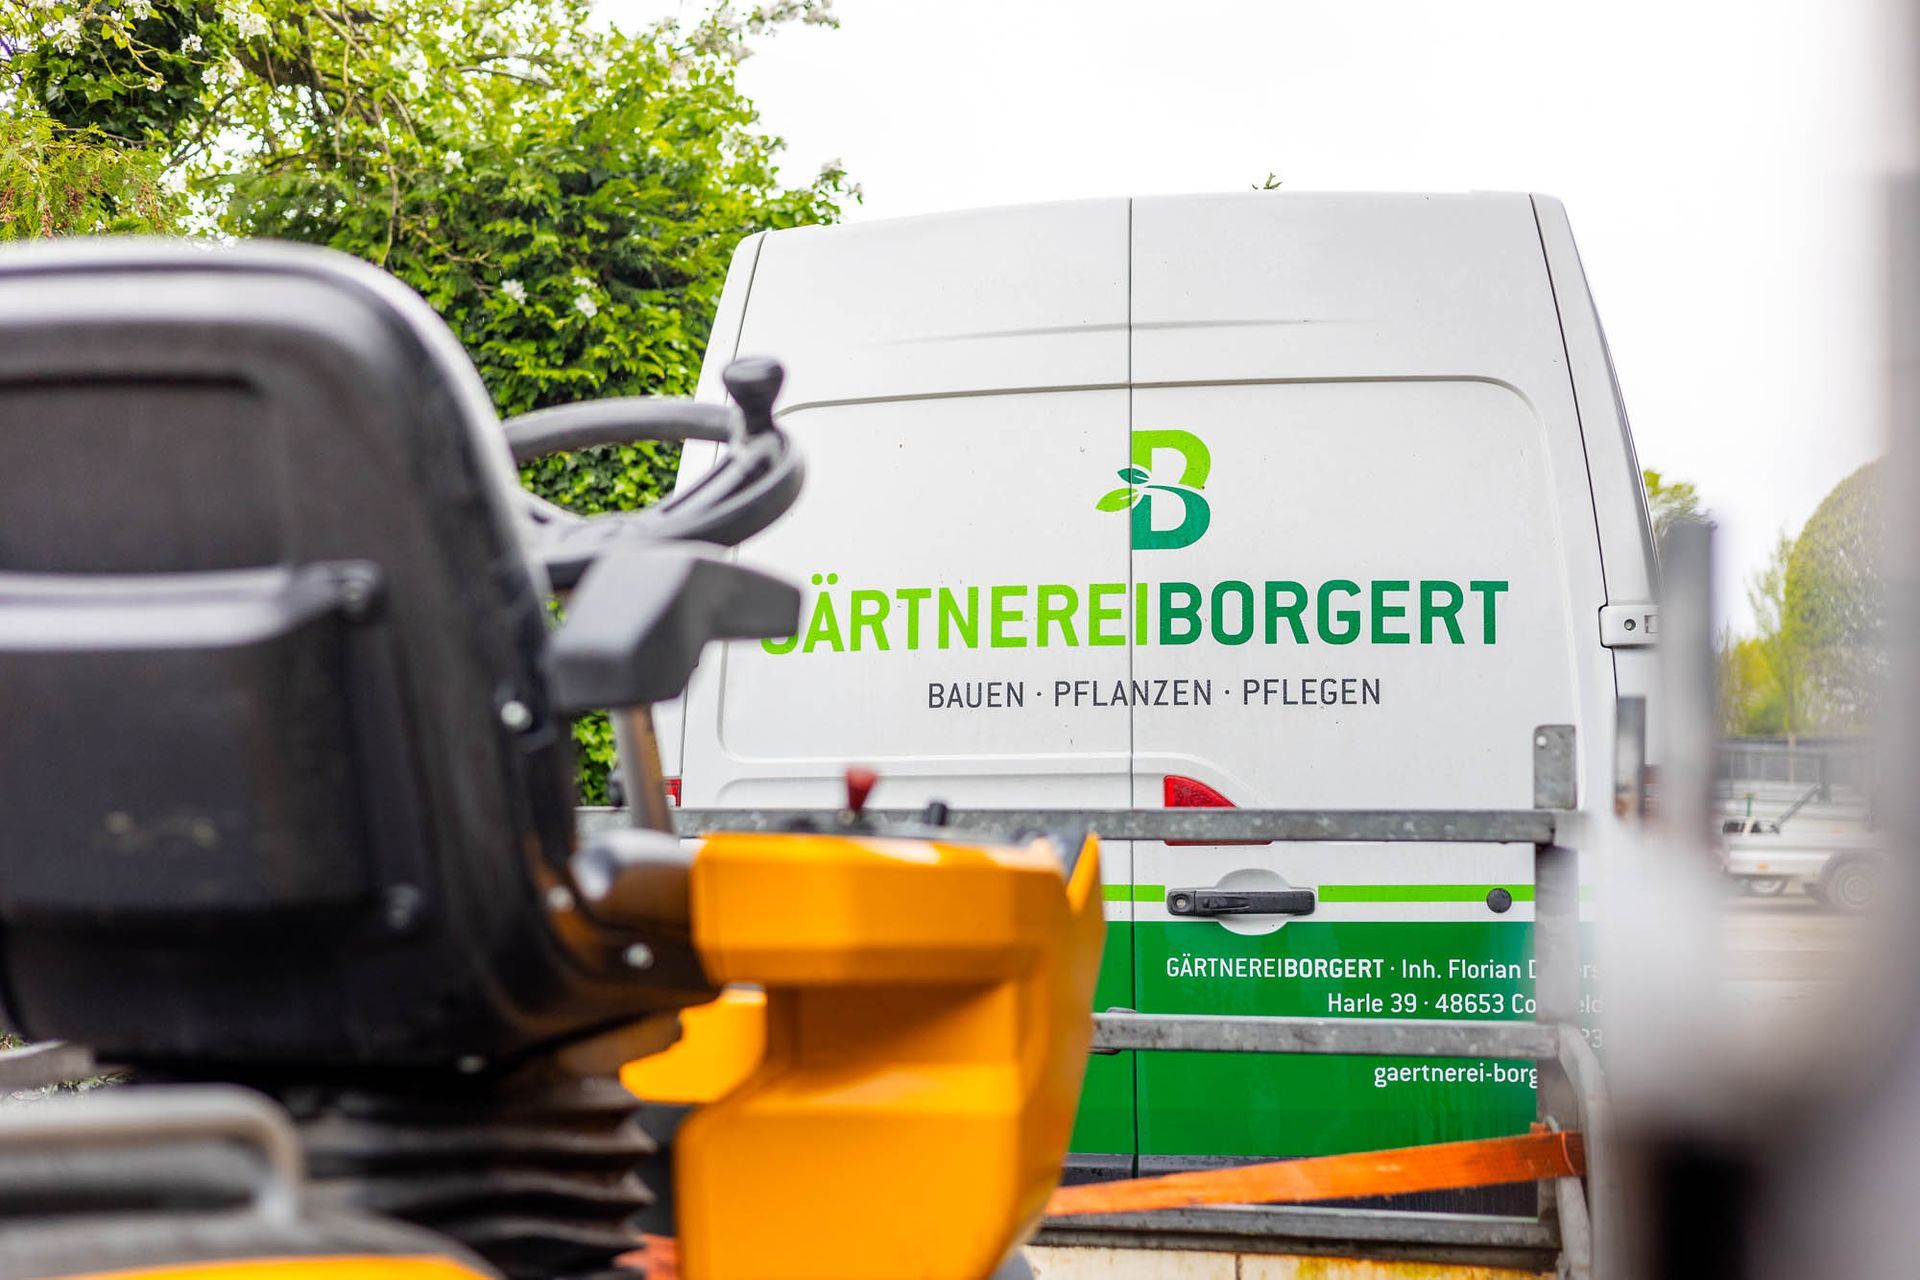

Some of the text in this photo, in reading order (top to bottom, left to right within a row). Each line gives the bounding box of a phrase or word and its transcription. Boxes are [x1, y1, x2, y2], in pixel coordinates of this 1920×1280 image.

[1131, 430, 1211, 550] B
[761, 572, 1509, 655] ÄRTNEREIBORGERT
[928, 677, 1381, 709] BAUEN PFLANZEN PFLEGEN
[1166, 953, 1385, 979] GÄRTNEREIBORGERT
[1402, 959, 1442, 979] Inh.
[1448, 959, 1521, 979] Florian
[1328, 993, 1383, 1013] Harle
[1390, 993, 1417, 1013] 39
[1435, 993, 1504, 1014] 48653
[1374, 1063, 1538, 1089] gaertnerei-borg
